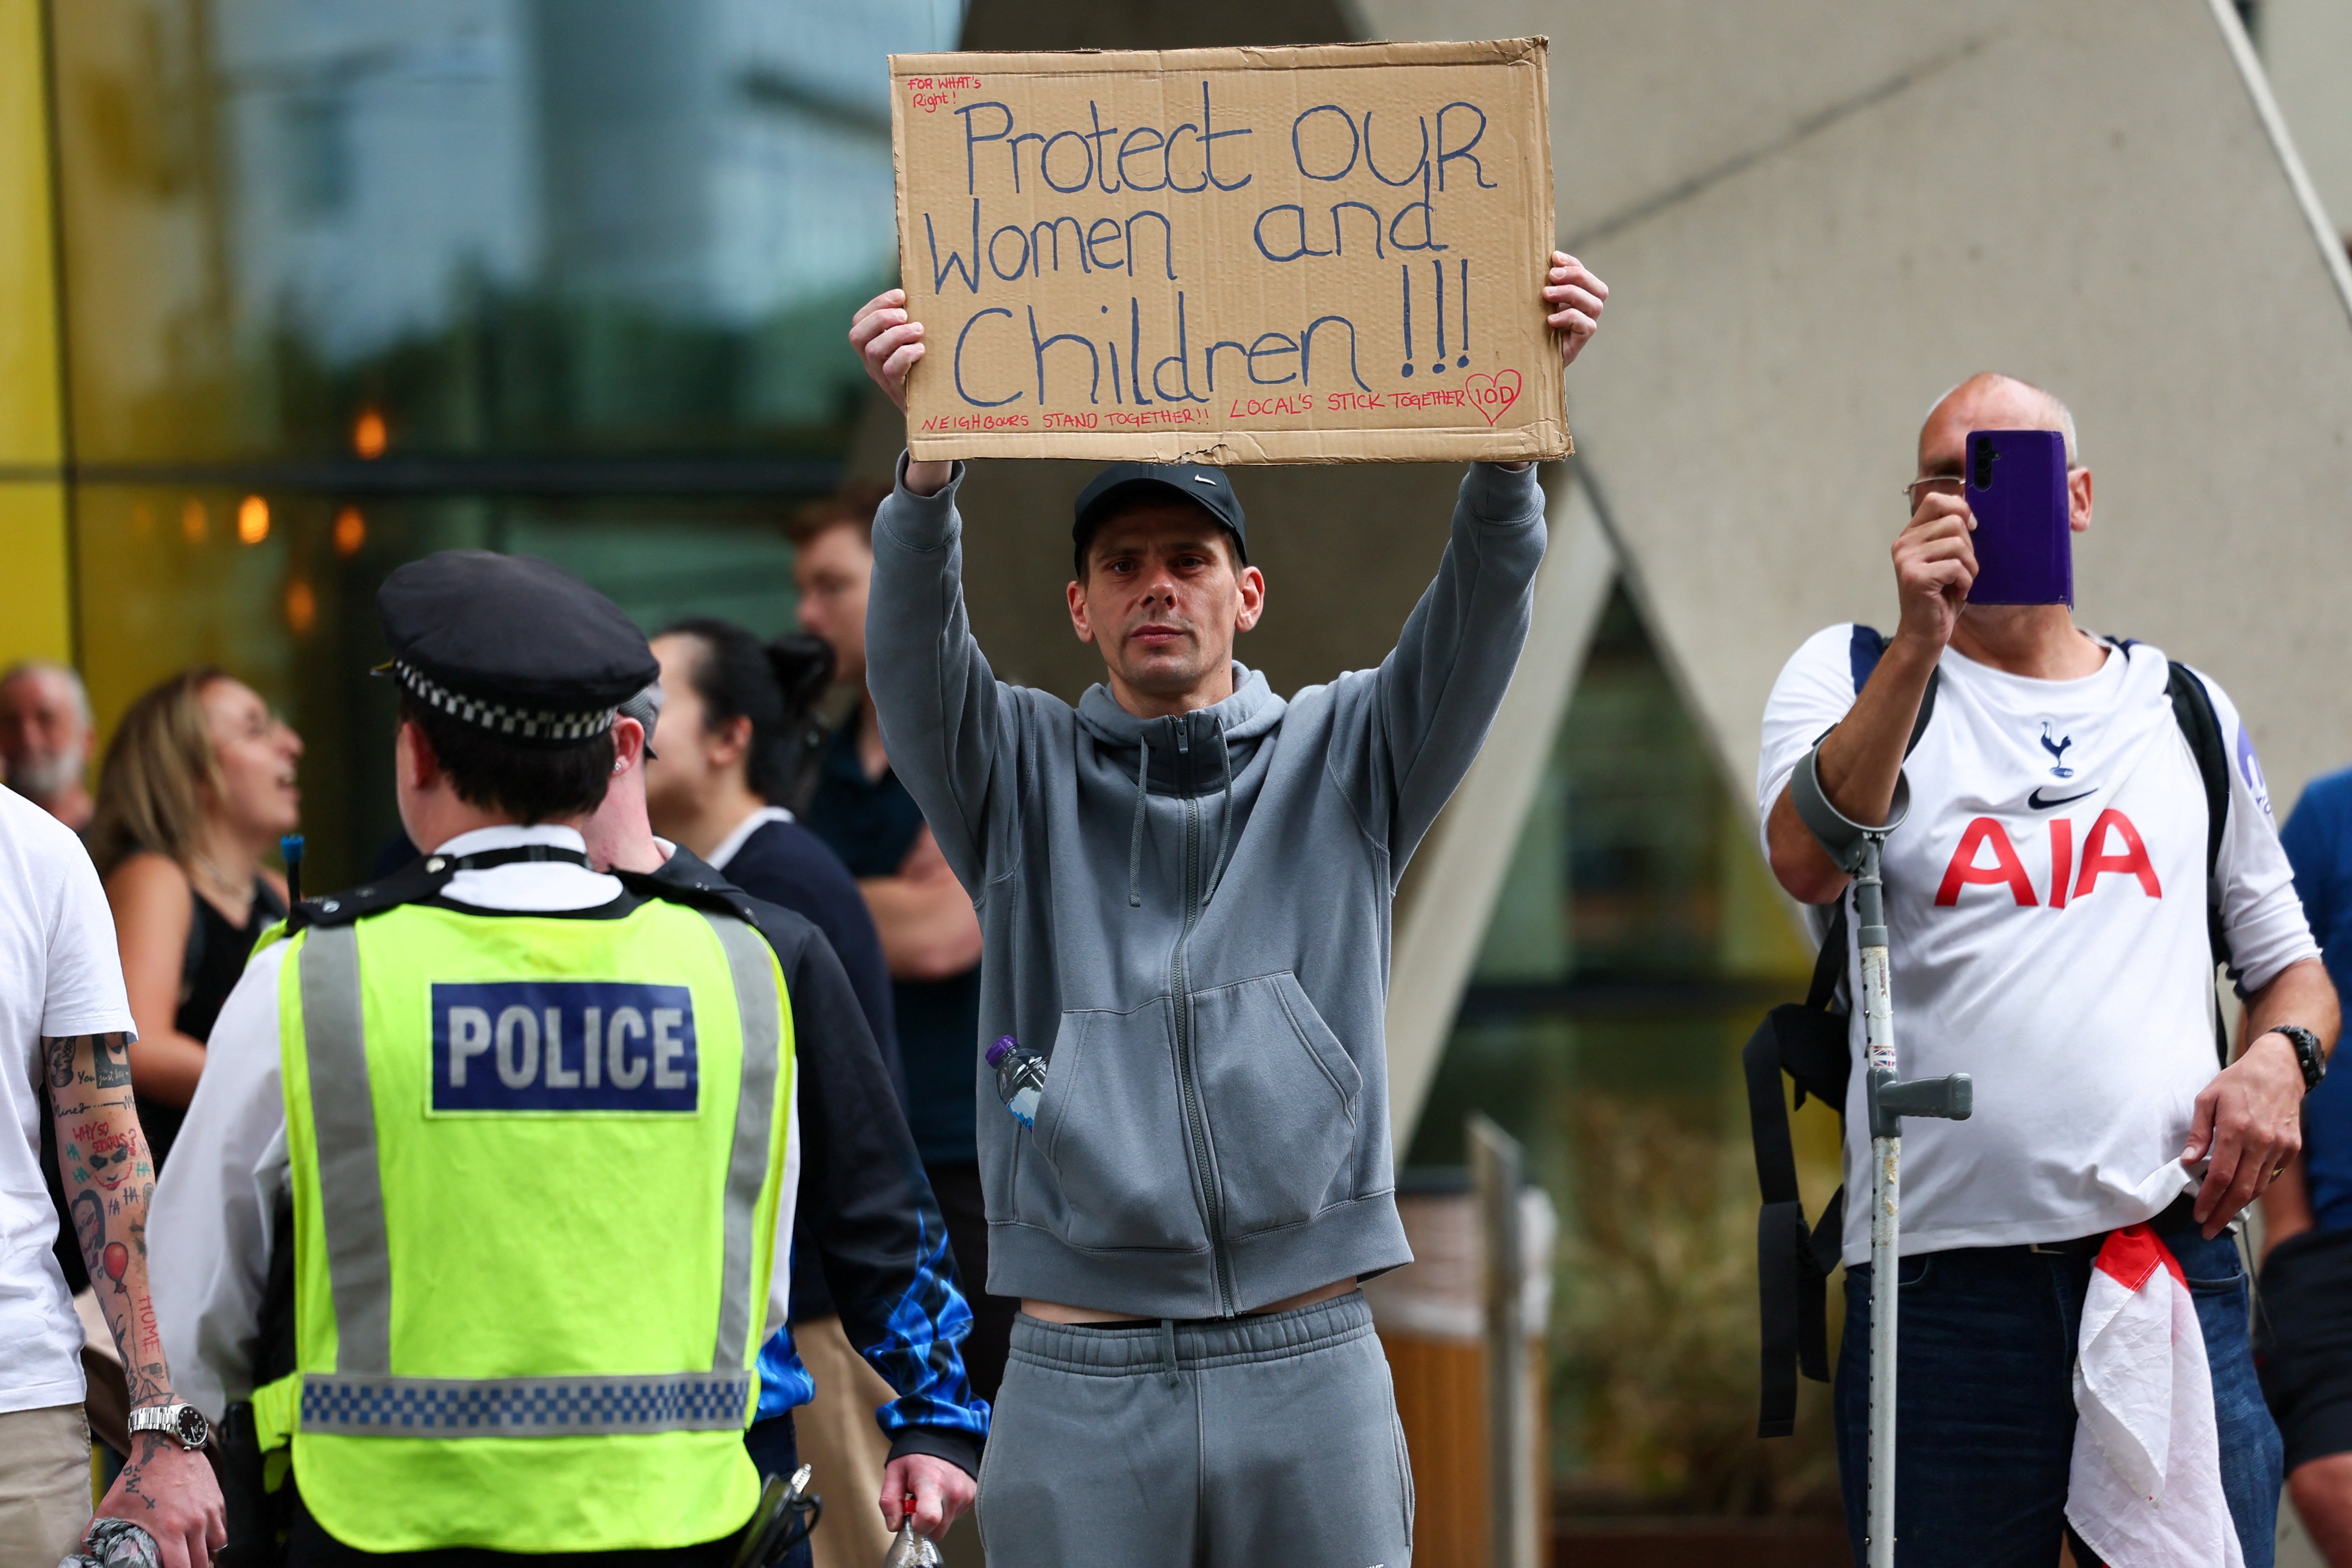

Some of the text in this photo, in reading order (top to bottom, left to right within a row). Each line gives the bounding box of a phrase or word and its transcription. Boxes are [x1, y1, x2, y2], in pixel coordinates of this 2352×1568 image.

[907, 78, 933, 90] FOR
[954, 81, 1497, 193] Protect OUR
[924, 160, 1449, 295] Women and
[921, 414, 1030, 431] NEIGHBOURS
[1042, 412, 1098, 429] STAND
[1229, 389, 1465, 418] LOCAL'S STICK TOGETHER
[1934, 808, 2162, 909] AIA
[448, 1004, 687, 1090] POLICE
